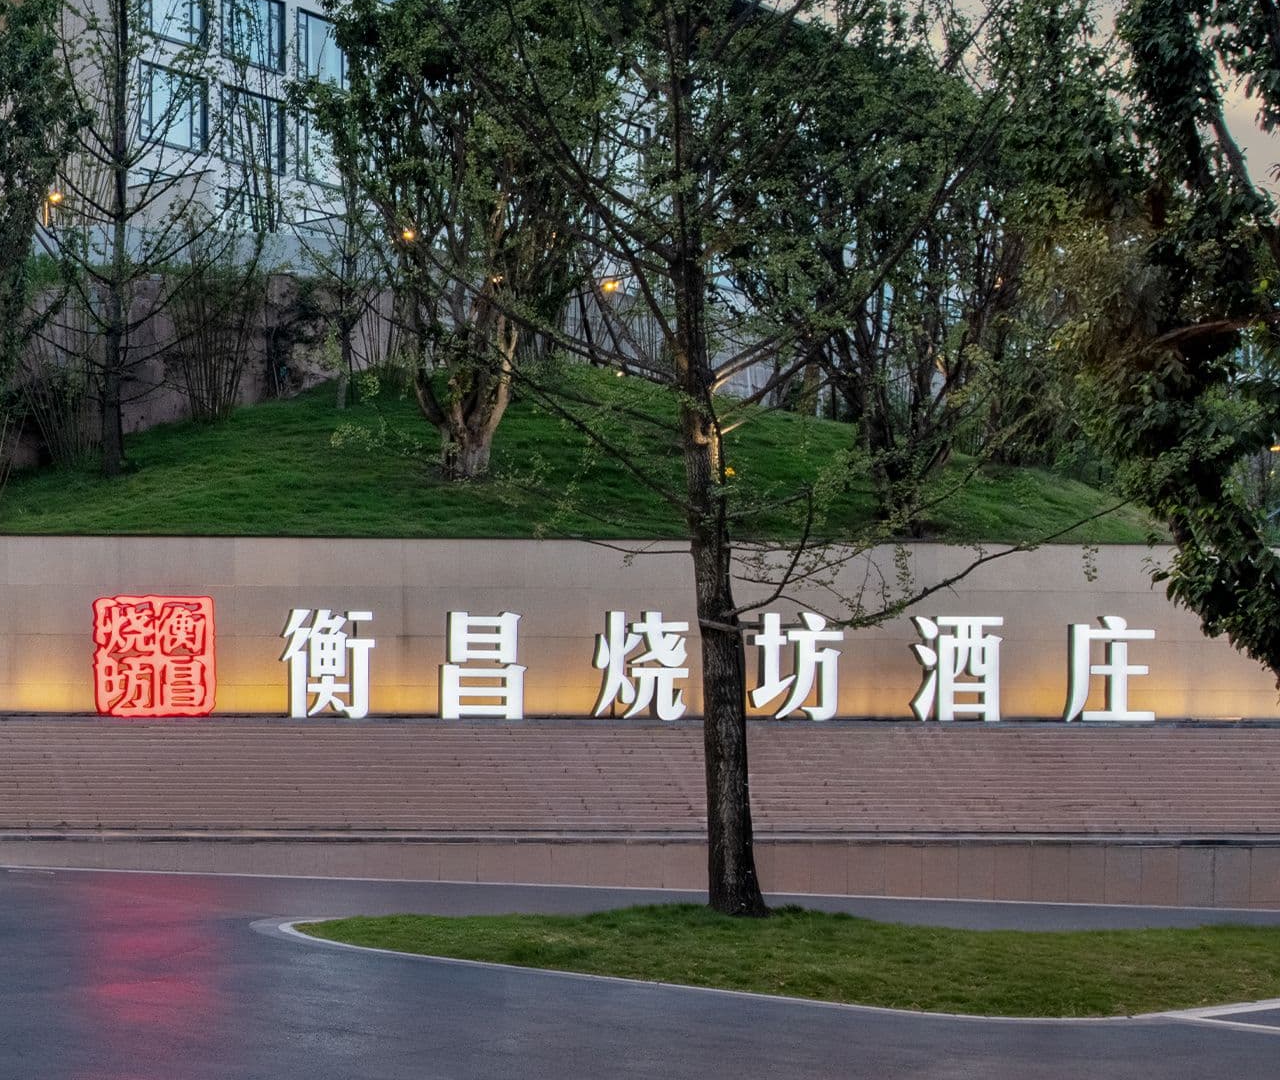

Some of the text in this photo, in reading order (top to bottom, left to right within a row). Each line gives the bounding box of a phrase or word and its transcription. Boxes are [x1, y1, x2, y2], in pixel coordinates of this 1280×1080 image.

[280, 608, 1156, 722] 衡昌烧坊酒庄
